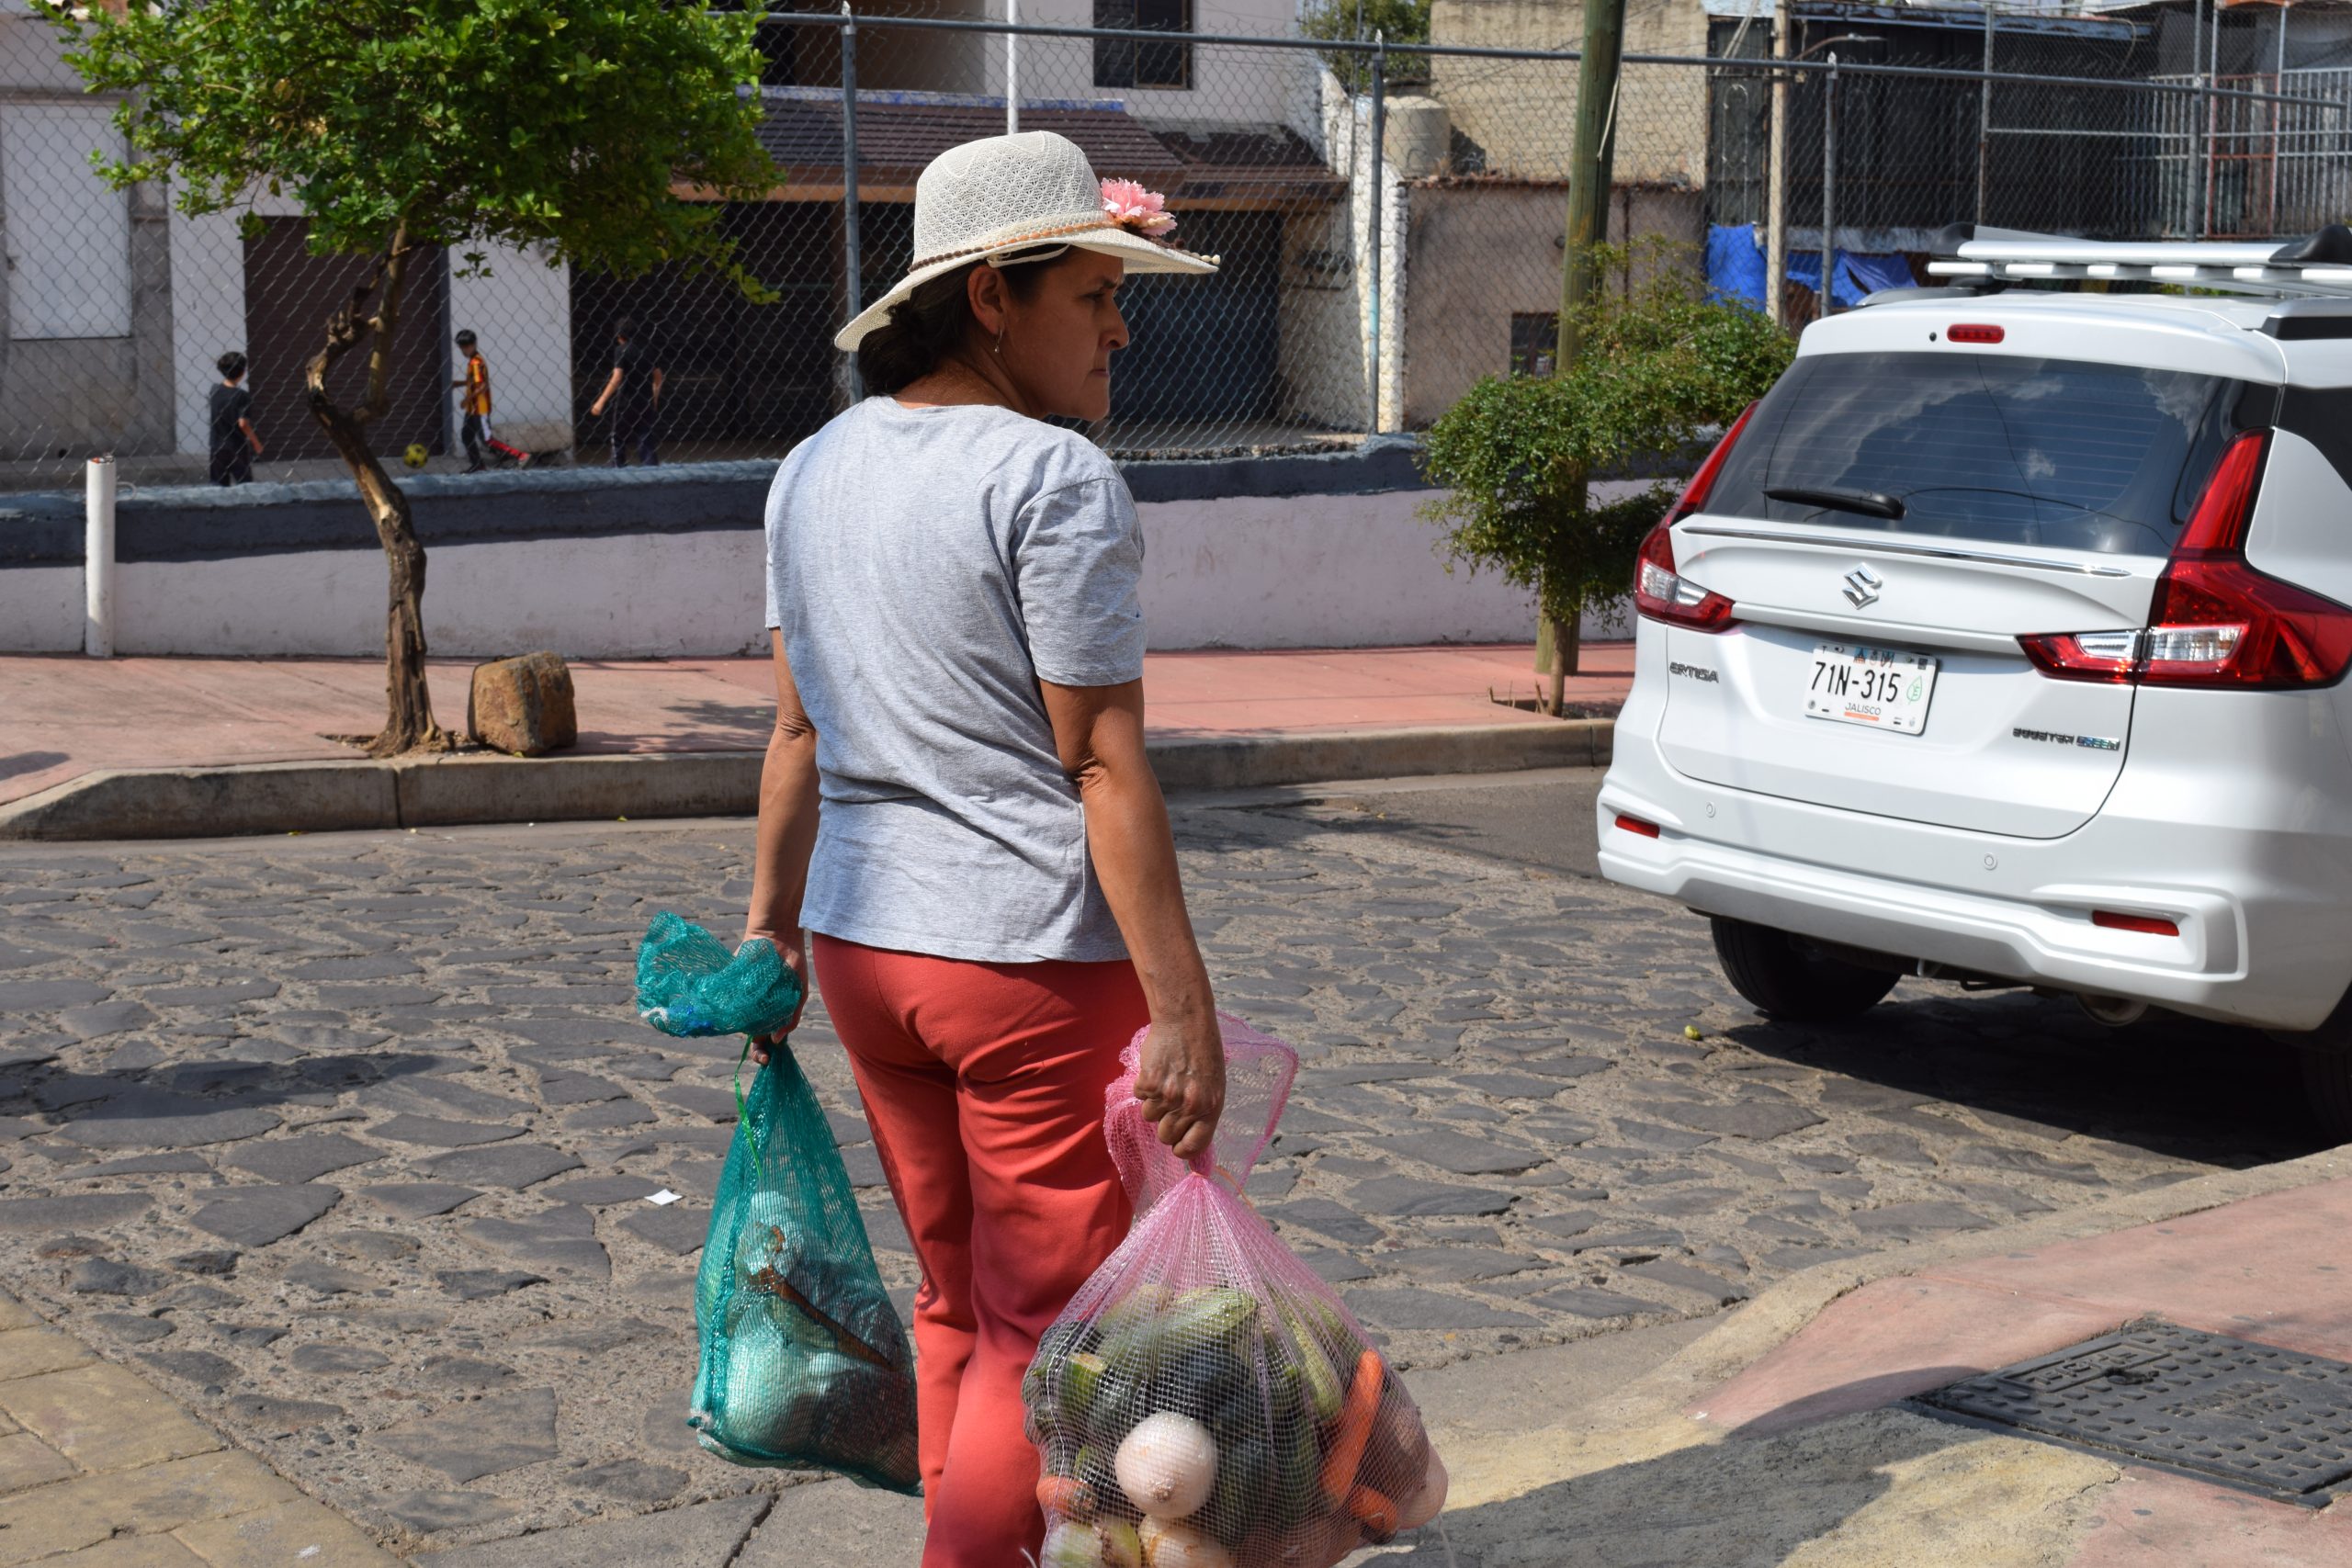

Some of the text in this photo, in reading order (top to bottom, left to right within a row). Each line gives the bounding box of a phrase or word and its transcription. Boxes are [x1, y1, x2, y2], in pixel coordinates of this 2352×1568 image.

[1669, 661, 1719, 683] ERTIGA
[1811, 660, 1901, 703] 71N-315
[1845, 702, 1882, 716] JALISCO
